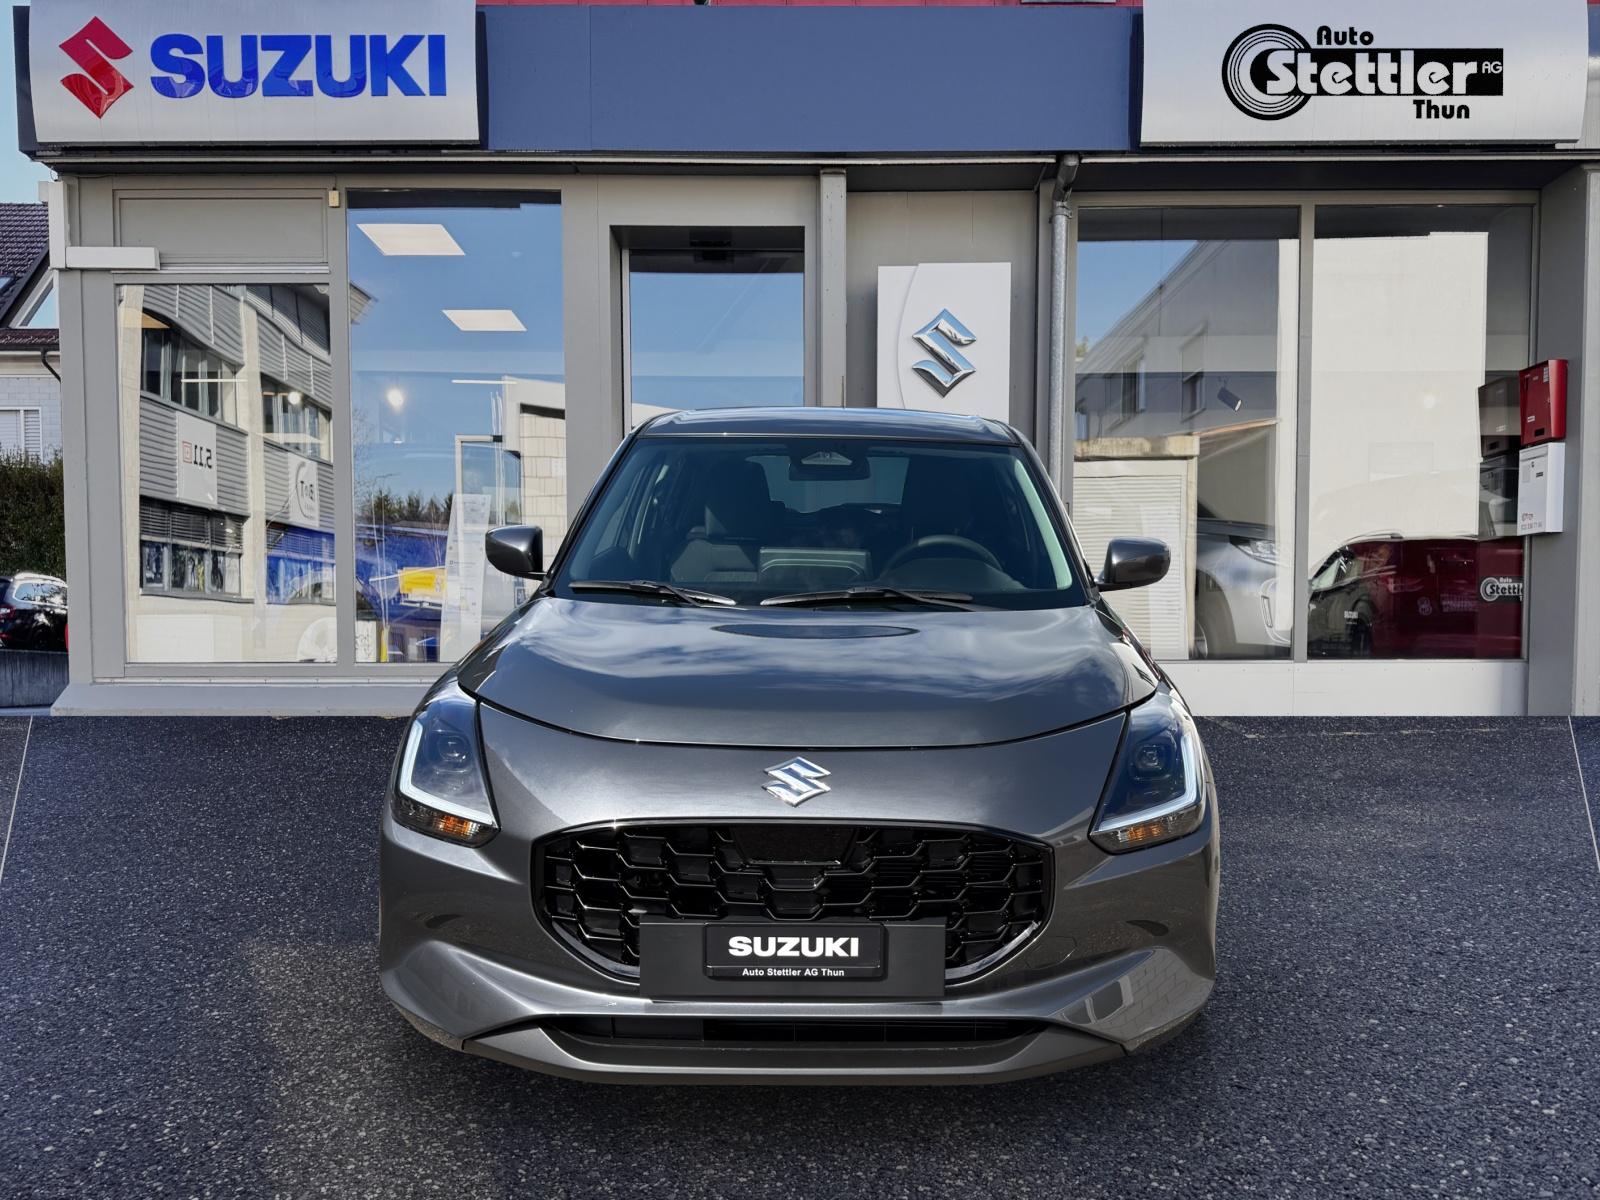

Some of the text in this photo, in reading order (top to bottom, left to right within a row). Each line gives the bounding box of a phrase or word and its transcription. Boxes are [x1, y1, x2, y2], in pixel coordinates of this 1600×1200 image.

[1316, 25, 1374, 46] Auto
[150, 33, 447, 99] SUZUKI
[1266, 49, 1503, 95] Stettler AG
[1413, 99, 1470, 119] Thun
[728, 935, 859, 957] SUZUKI
[742, 968, 845, 977] Auto Stettler AG Thun
